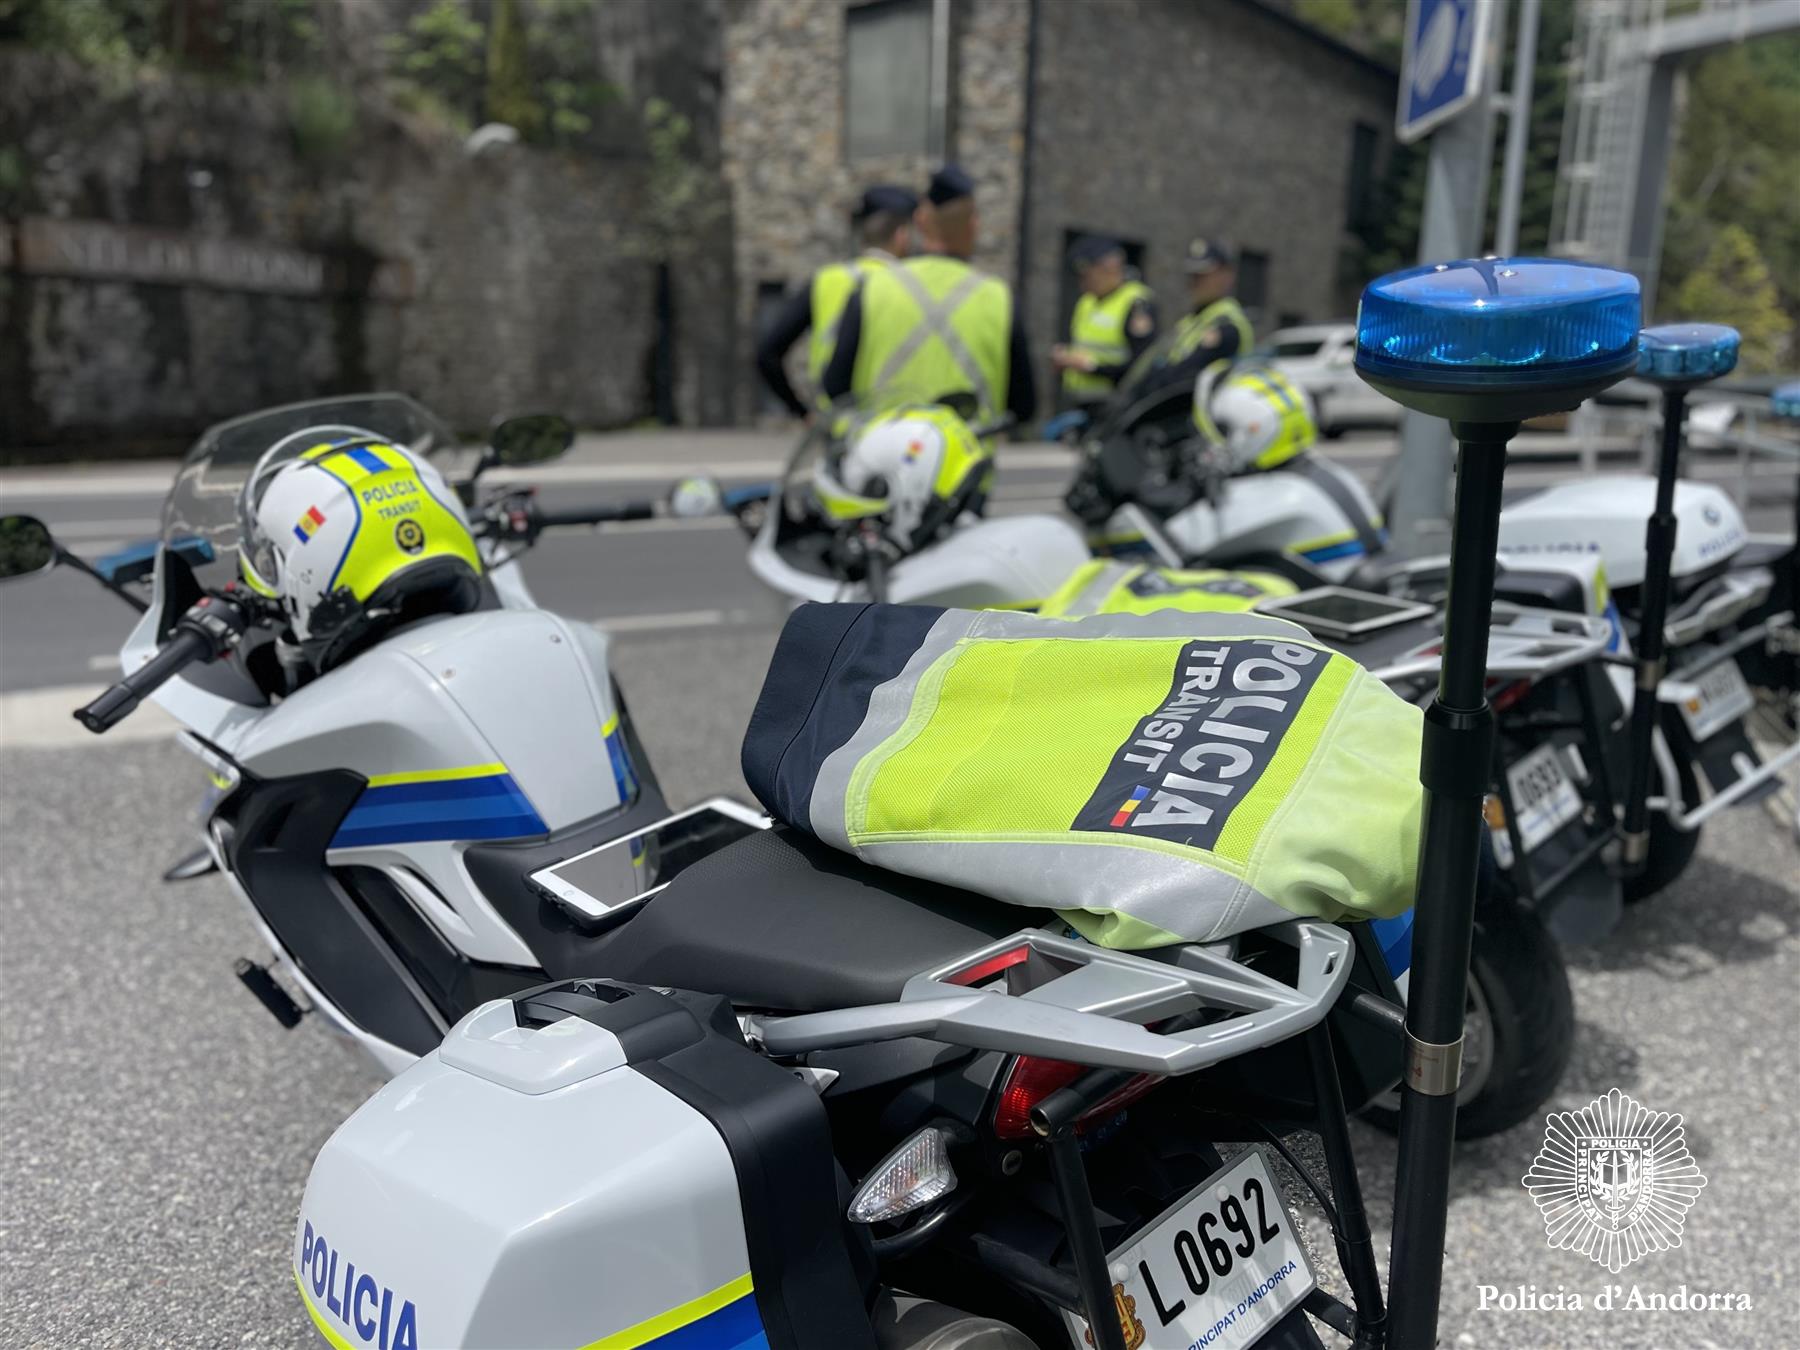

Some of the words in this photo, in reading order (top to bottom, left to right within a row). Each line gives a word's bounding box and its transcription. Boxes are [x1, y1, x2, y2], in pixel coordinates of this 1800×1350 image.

[362, 480, 418, 505] POLICIA
[1123, 646, 1231, 773] TRÀNSIT
[1131, 640, 1318, 827] POLICIA
[301, 1218, 418, 1350] POLICIA
[1237, 1260, 1297, 1316] D'ANDORRA
